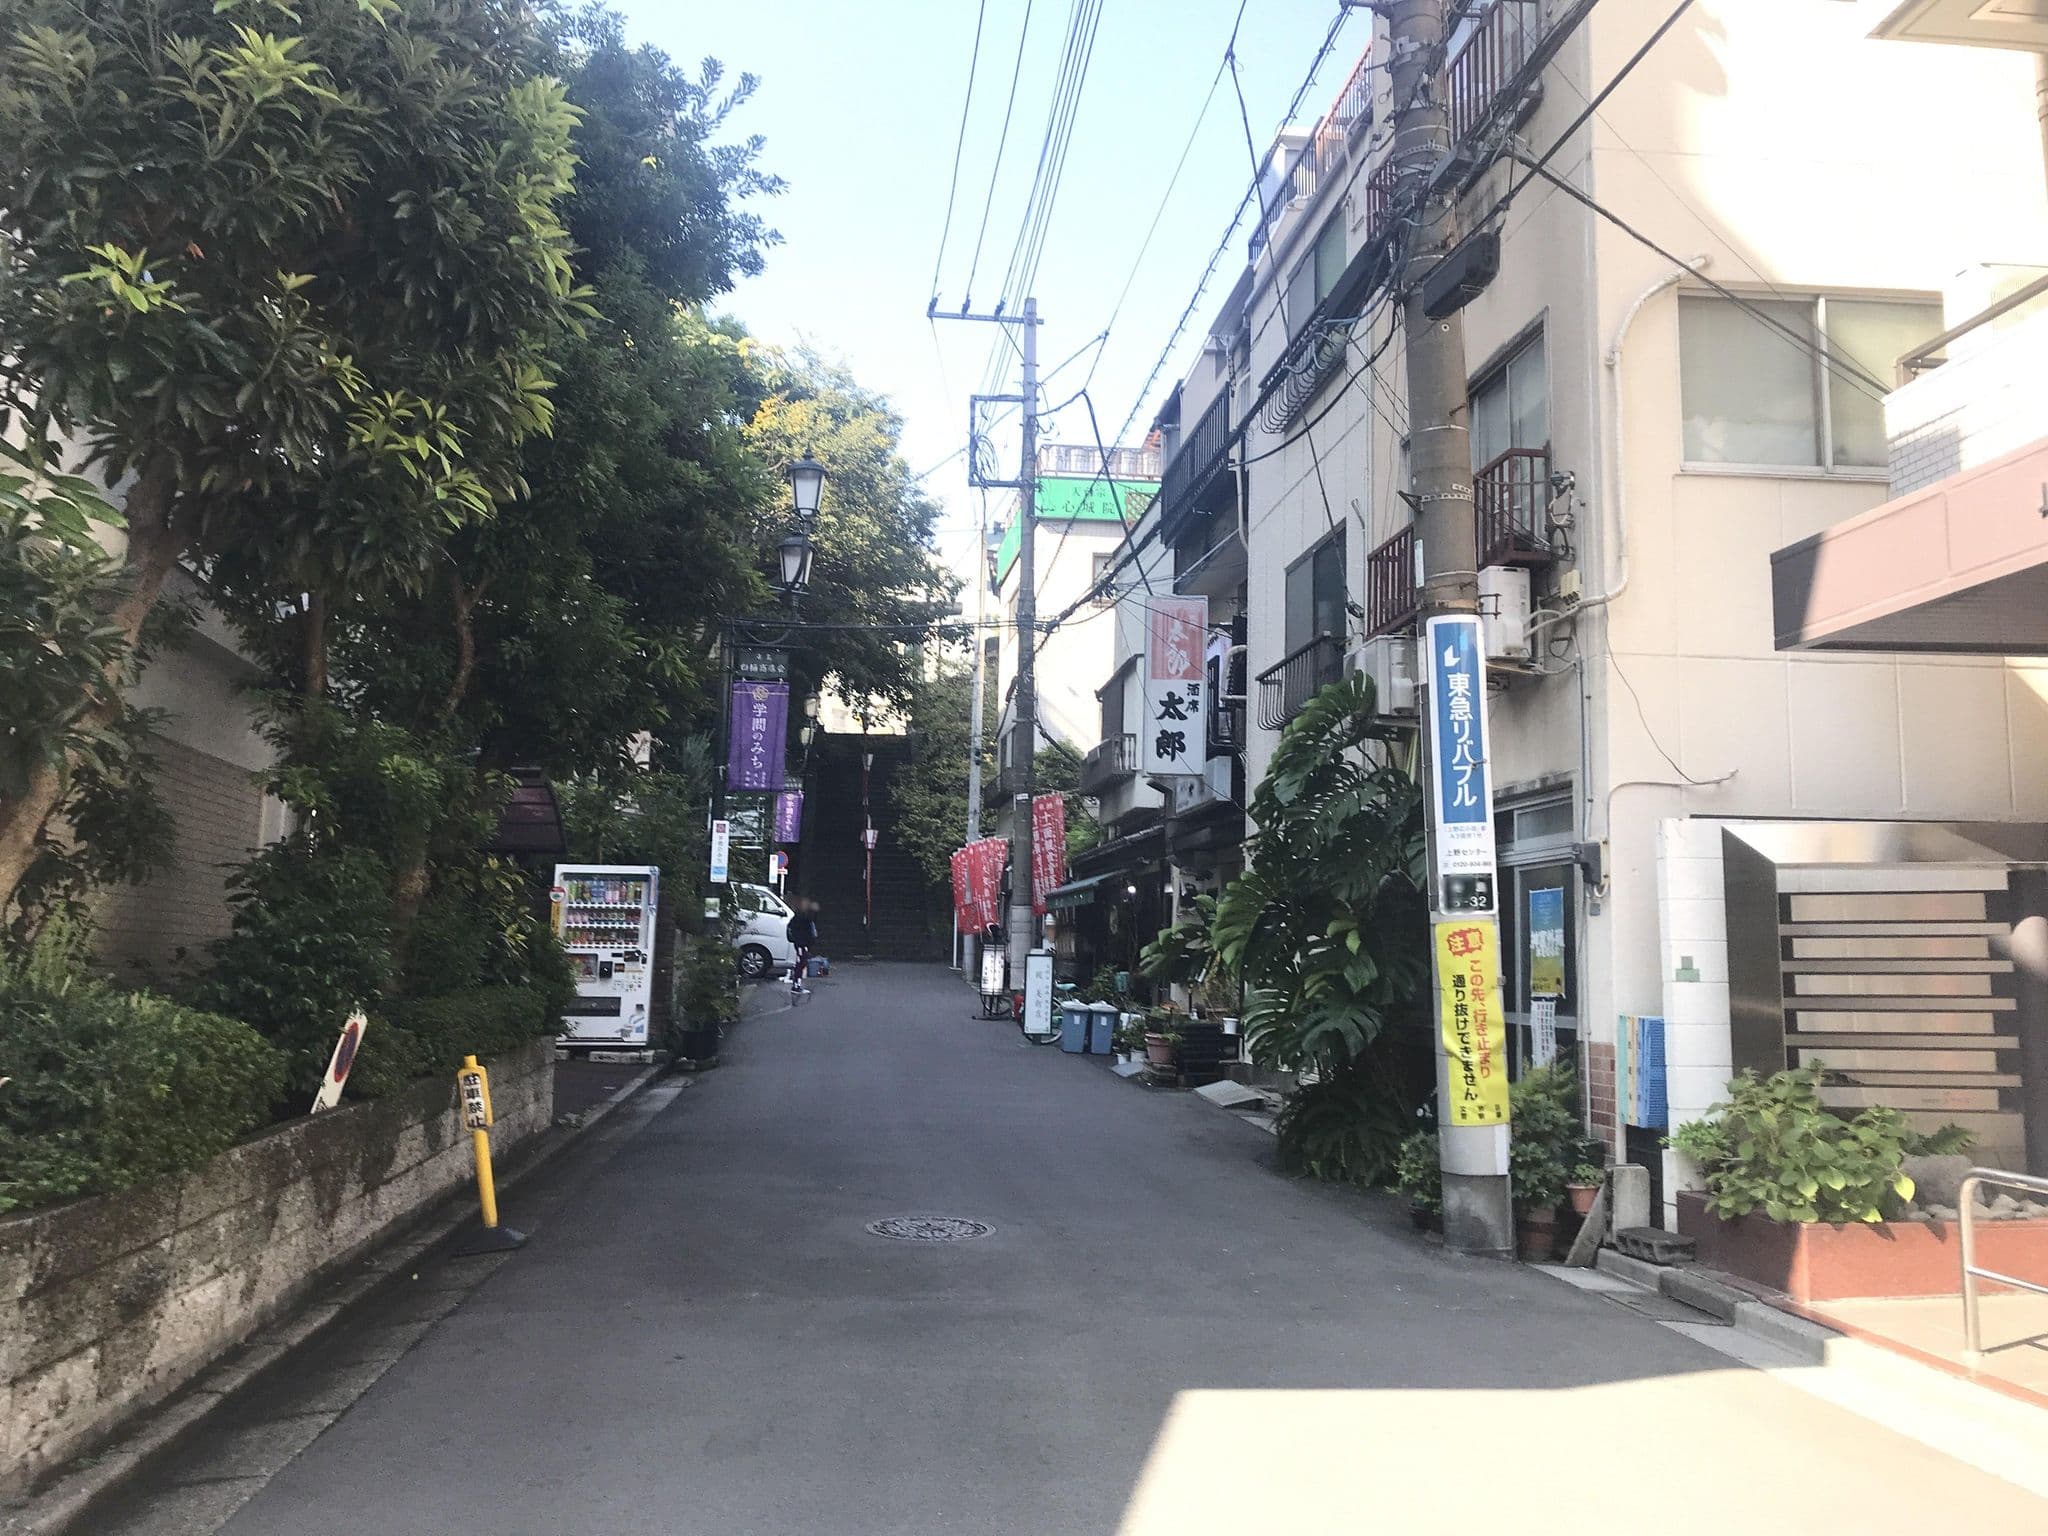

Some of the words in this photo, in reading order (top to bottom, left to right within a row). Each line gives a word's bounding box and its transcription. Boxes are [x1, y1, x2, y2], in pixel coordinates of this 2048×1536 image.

[750, 703, 768, 769] 学問のみち
[1156, 691, 1188, 762] 太郎
[1447, 672, 1477, 807] 東急リバブル
[1452, 974, 1478, 1101] 通り抜けできません
[1470, 959, 1491, 1079] この先、行き止まり
